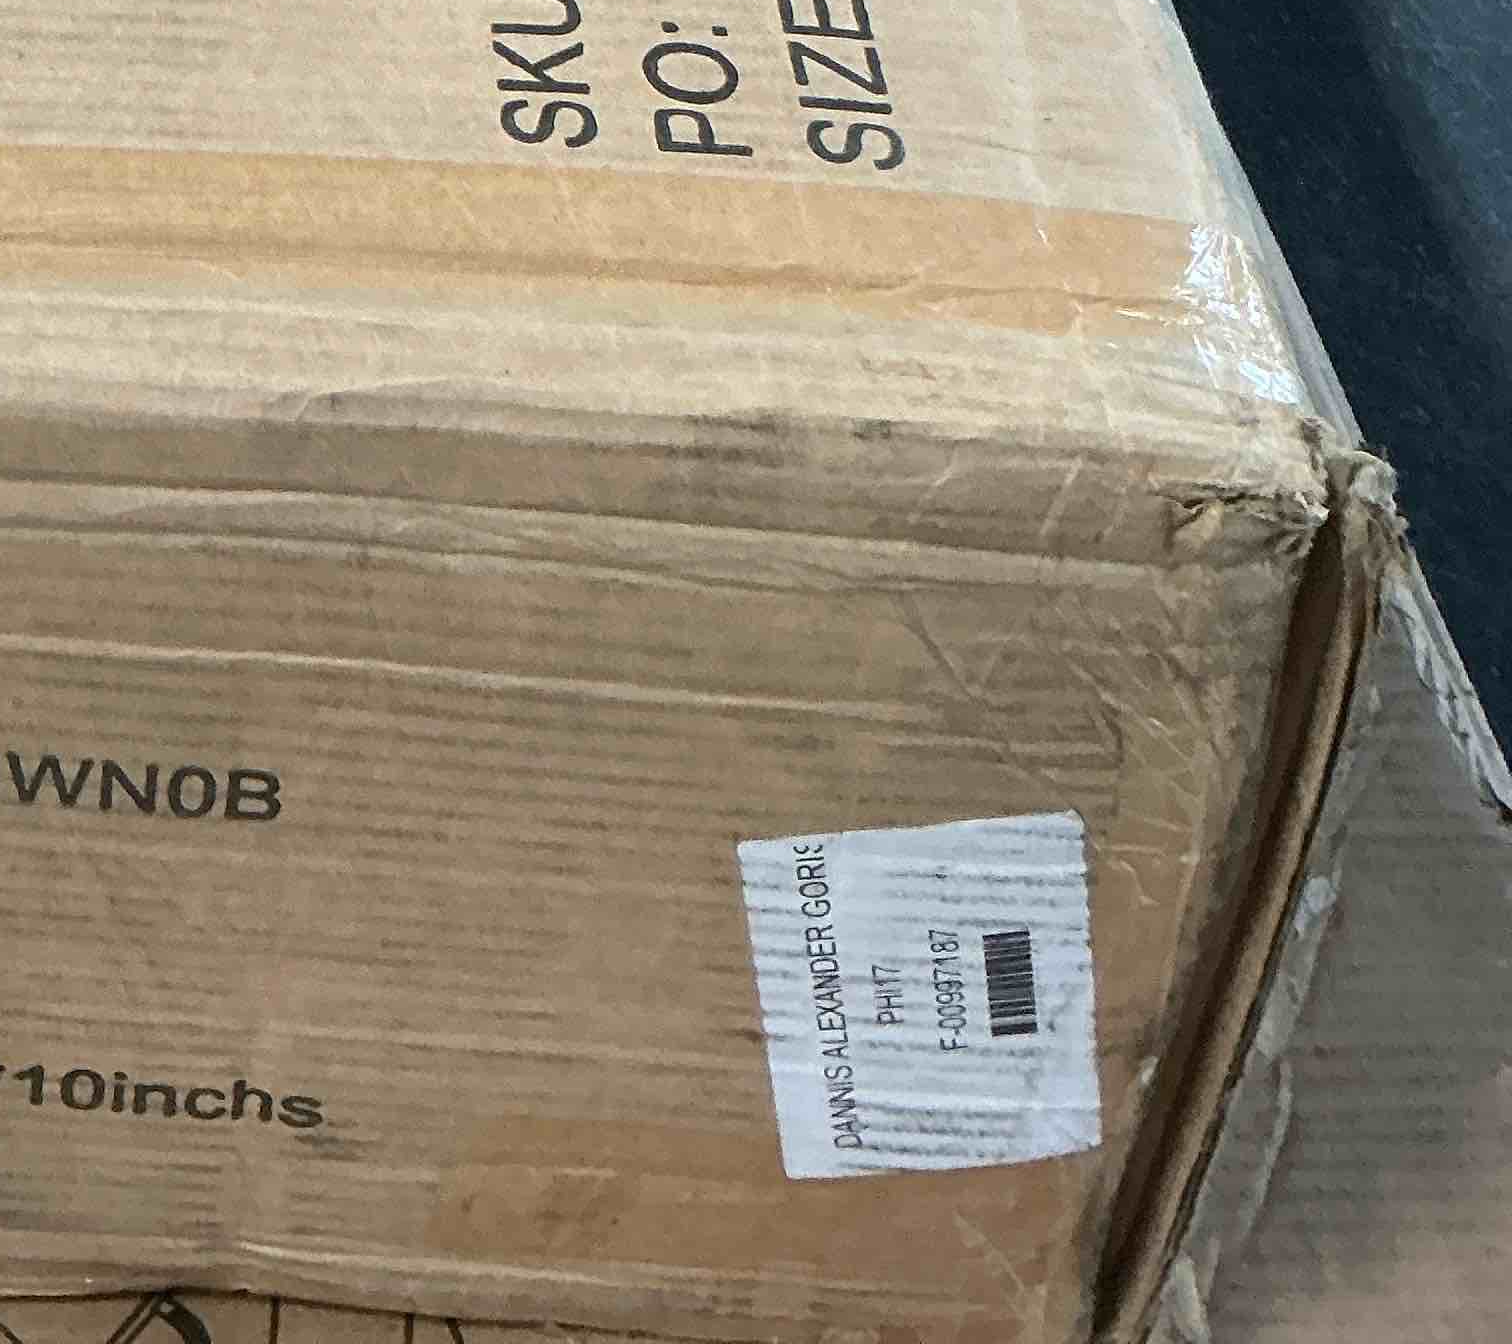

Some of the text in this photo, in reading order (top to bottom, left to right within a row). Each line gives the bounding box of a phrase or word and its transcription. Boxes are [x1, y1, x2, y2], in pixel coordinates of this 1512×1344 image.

[643, 23, 752, 158] PO:
[804, 925, 849, 1060] ALEXANDER
[928, 928, 969, 1052] F-00997187
[823, 1064, 863, 1150] DANNIS
